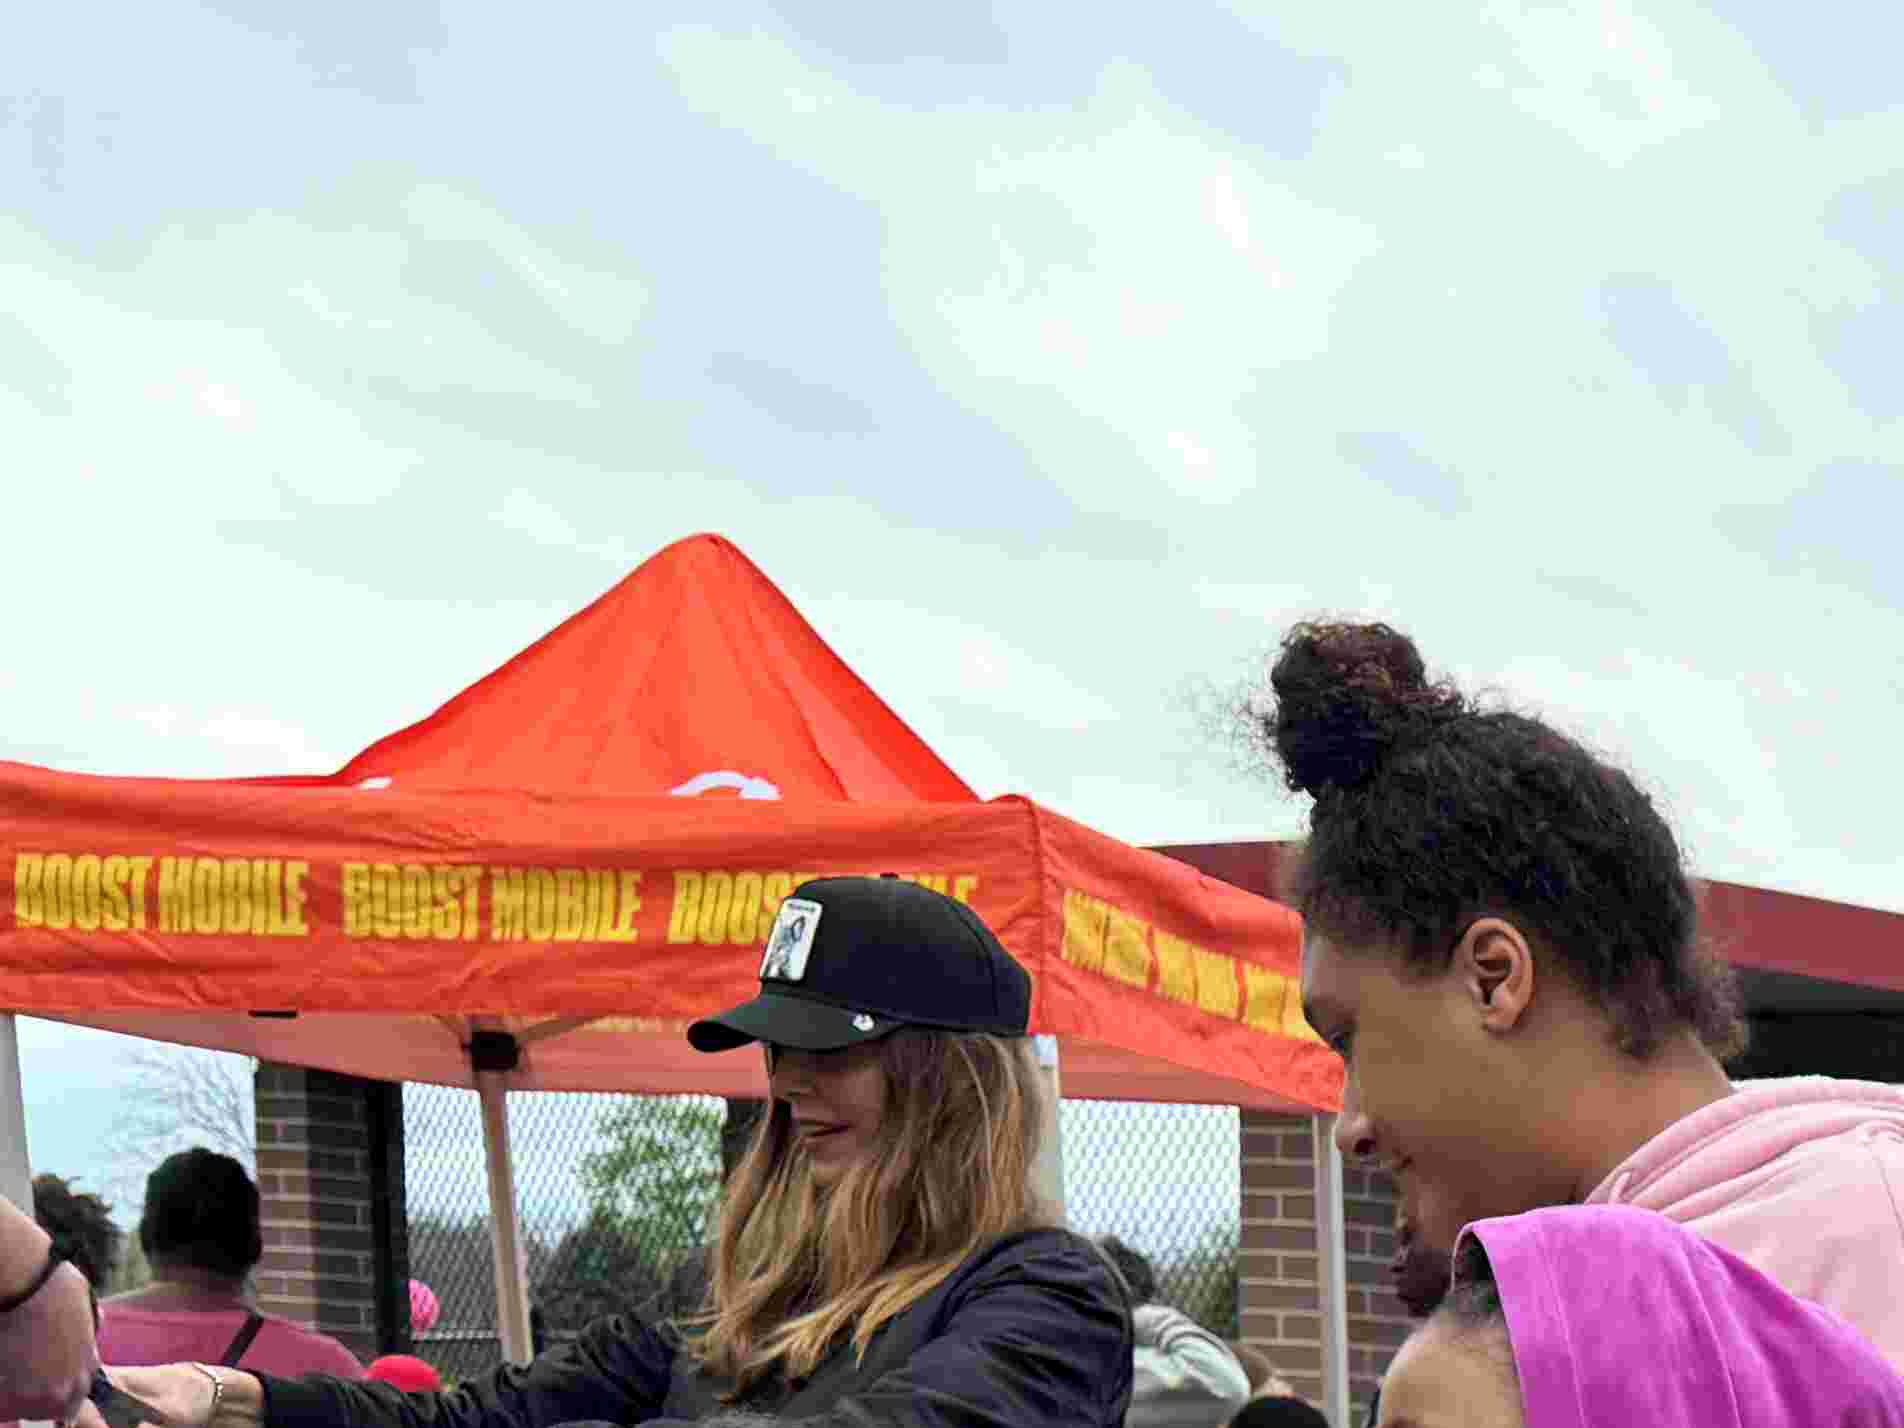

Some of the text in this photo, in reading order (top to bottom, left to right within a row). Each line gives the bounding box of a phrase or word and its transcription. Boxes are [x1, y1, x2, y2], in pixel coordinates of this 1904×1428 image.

[15, 853, 309, 937] BOOST MOBILE
[343, 863, 641, 943] BOOST MOBILE
